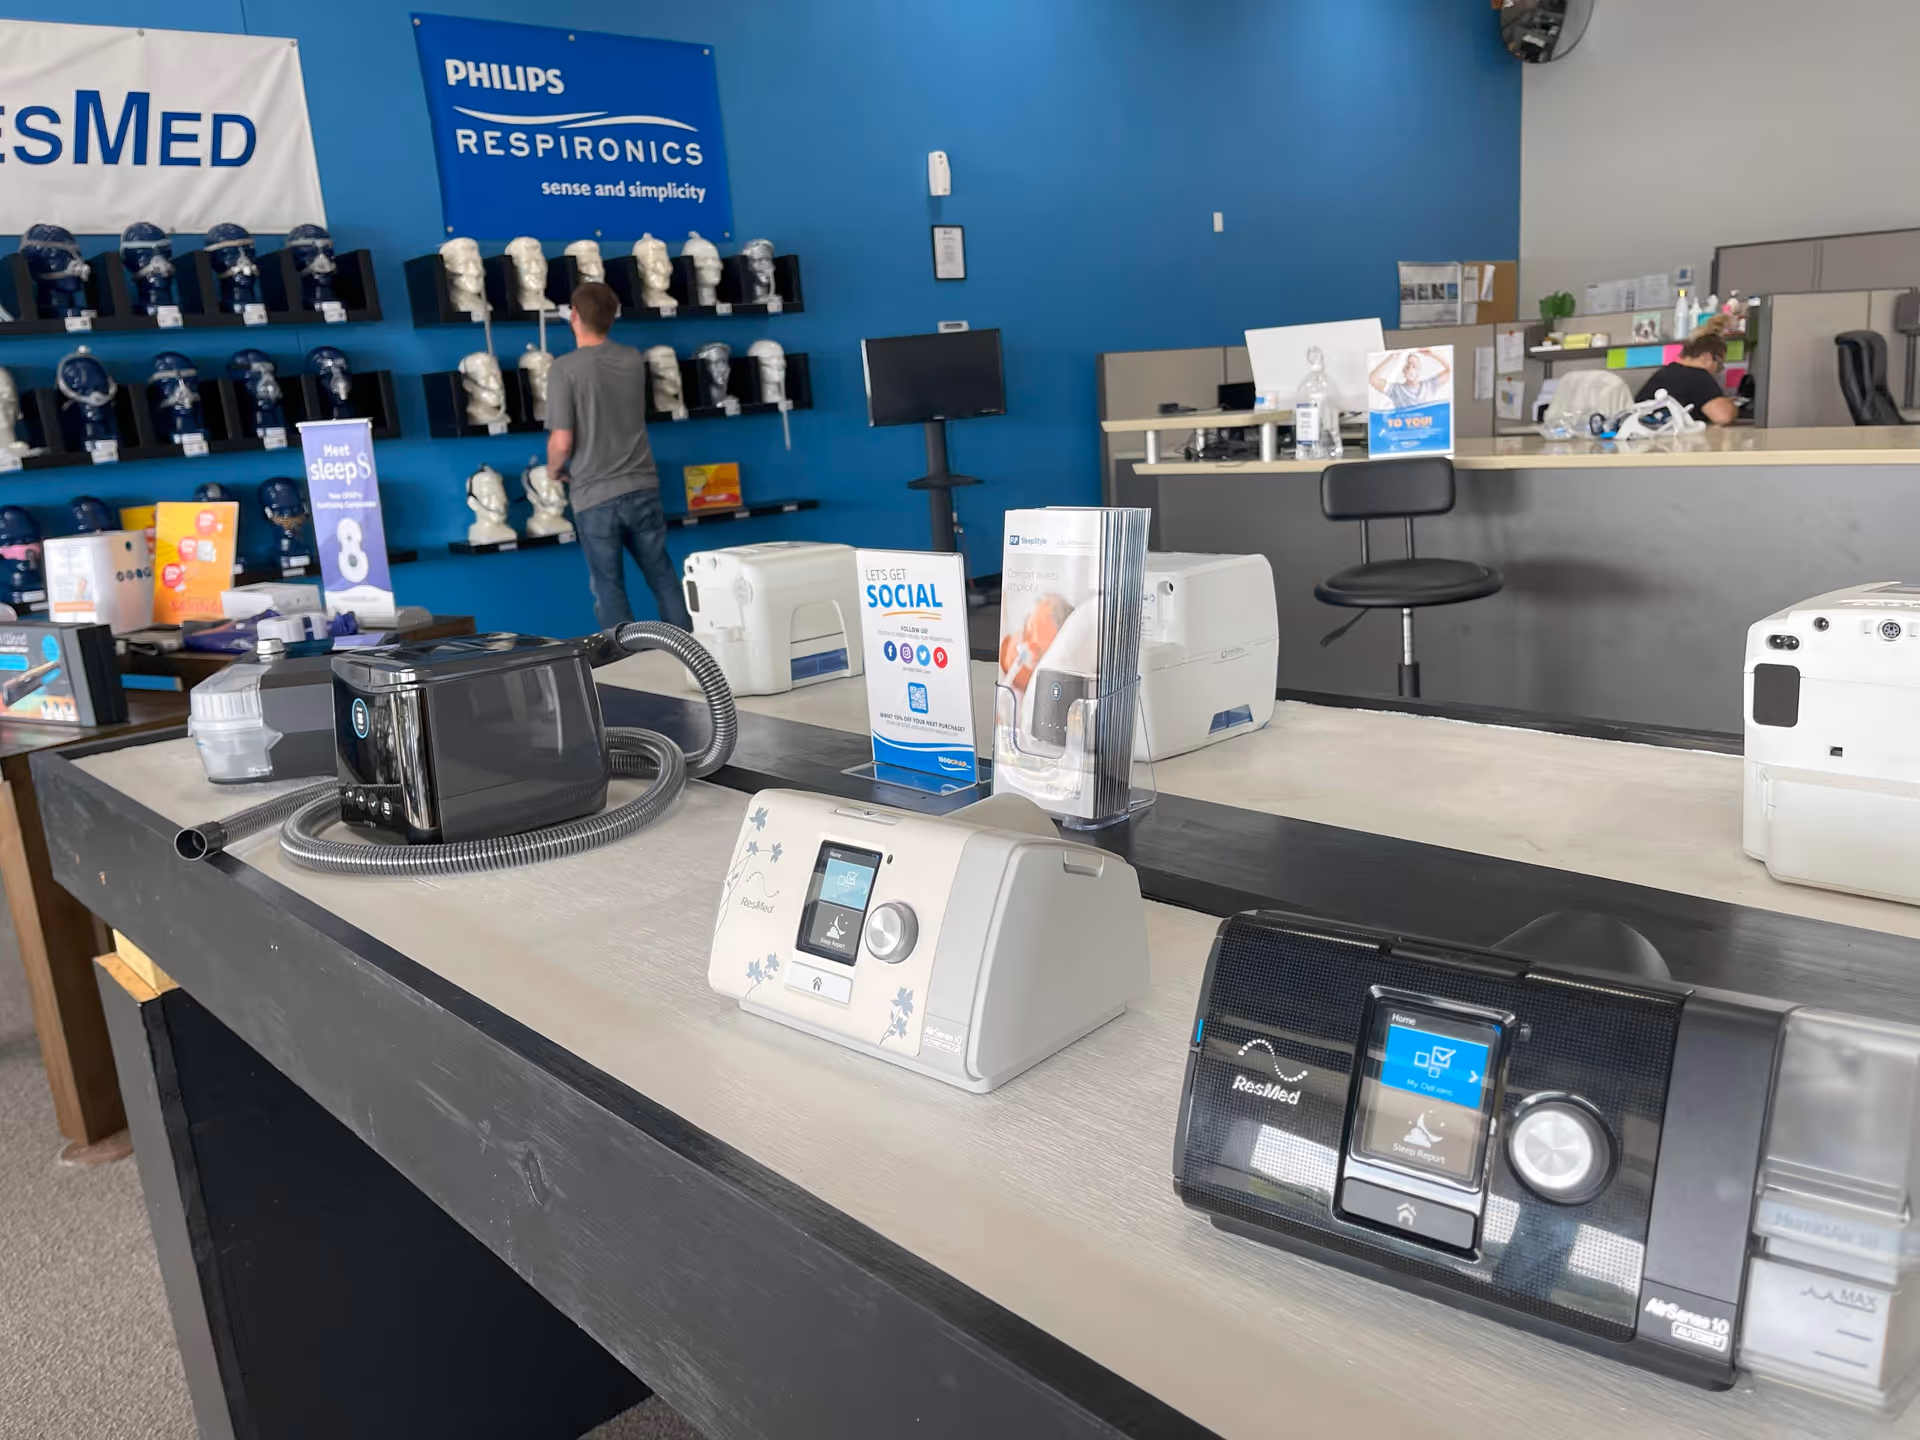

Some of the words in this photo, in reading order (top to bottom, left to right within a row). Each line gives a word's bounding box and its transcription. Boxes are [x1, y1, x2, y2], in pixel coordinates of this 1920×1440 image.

[445, 58, 565, 95] PHILIPS
[455, 128, 704, 166] RESPIRONICS
[541, 181, 592, 196] sense
[594, 180, 626, 197] and
[628, 181, 706, 203] simplicity
[323, 443, 351, 457] Meet
[865, 568, 888, 581] LET'S
[889, 568, 907, 580] GET
[866, 583, 943, 608] SOCIAL
[900, 625, 920, 634] FOLLOW
[740, 896, 775, 914] ResMed
[1391, 1013, 1417, 1026] Home
[1232, 1074, 1301, 1105] ResMed
[1406, 1079, 1419, 1090] My
[1392, 1142, 1416, 1157] Sleep
[1416, 1149, 1446, 1165] Report
[1840, 1288, 1877, 1306] MAX
[1711, 1317, 1730, 1335] 10
